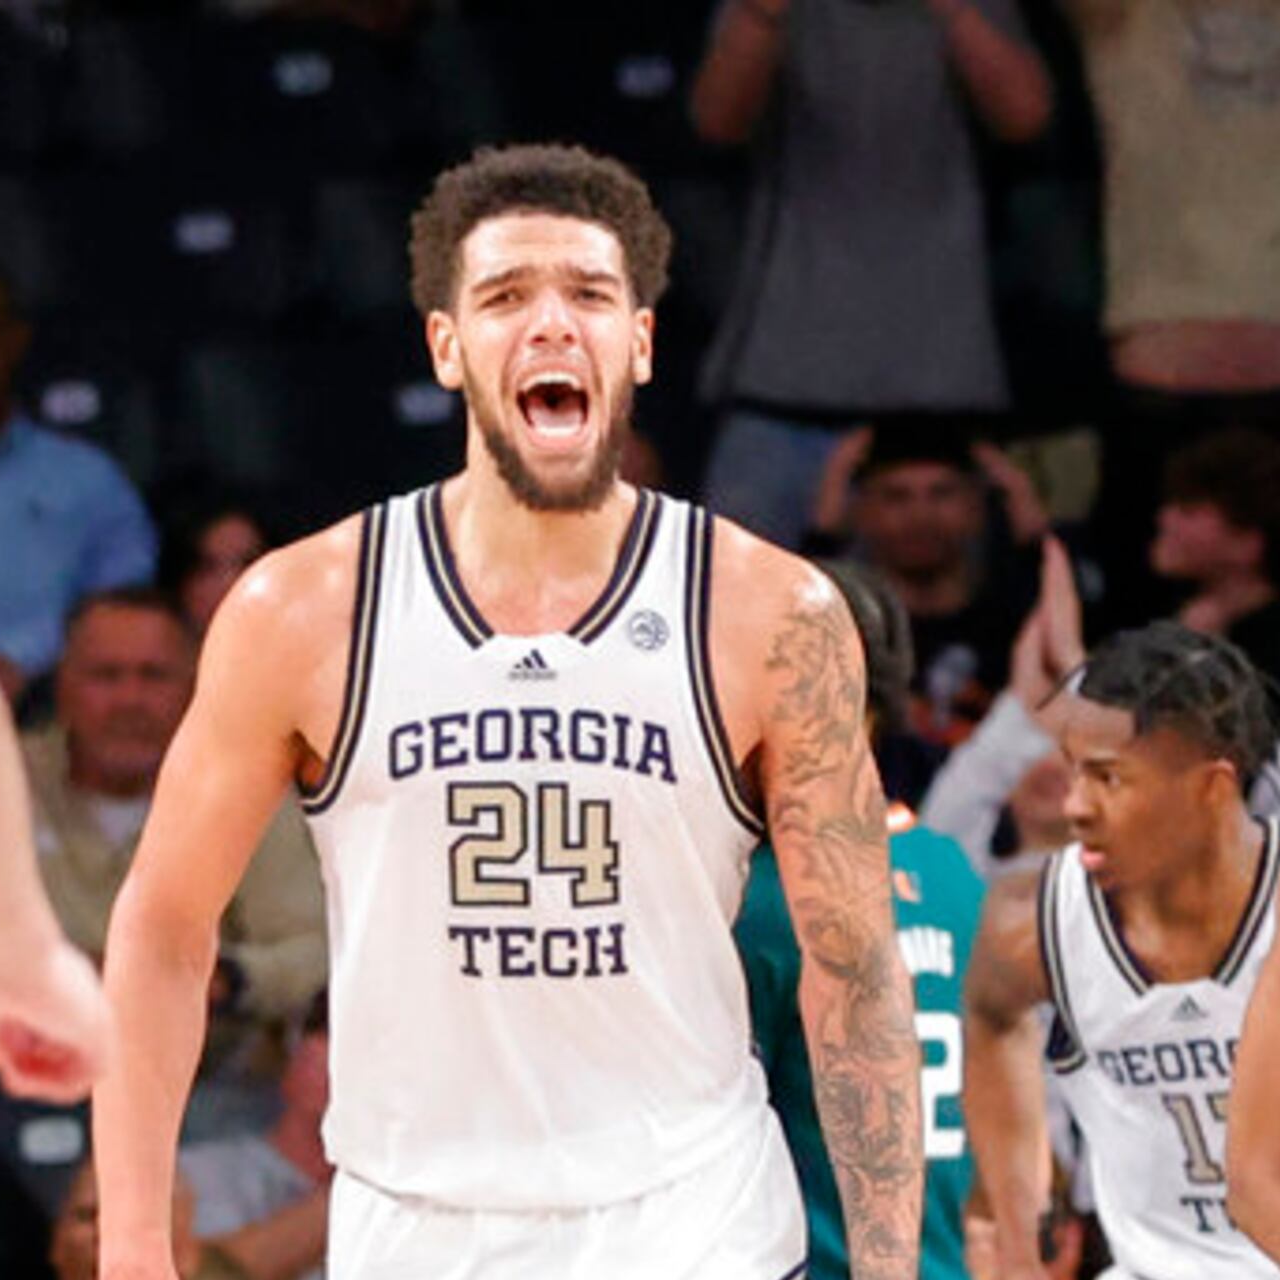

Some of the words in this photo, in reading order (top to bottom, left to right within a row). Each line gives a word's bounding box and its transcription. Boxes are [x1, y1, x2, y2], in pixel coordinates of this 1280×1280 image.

[388, 707, 678, 784] GEORGIA
[446, 781, 621, 908] 24
[448, 924, 629, 978] TECH
